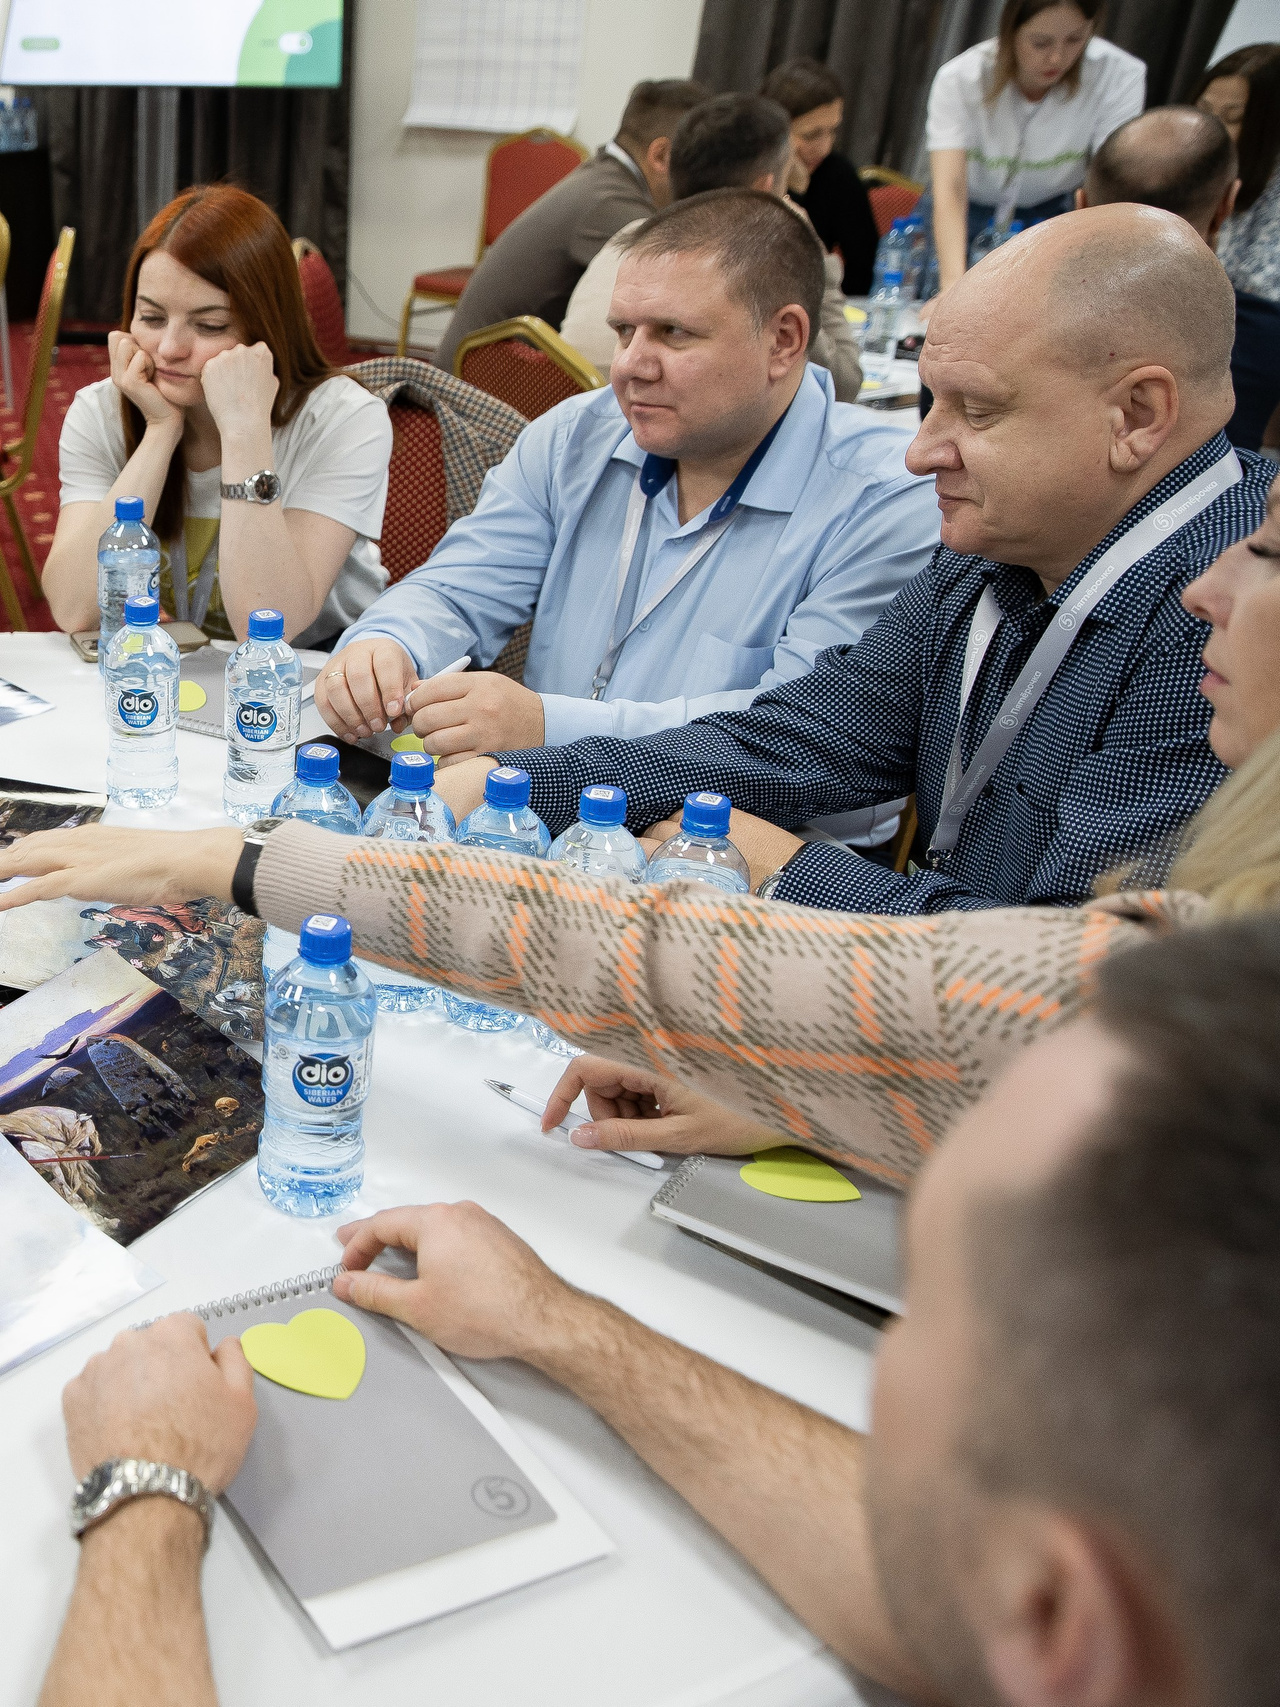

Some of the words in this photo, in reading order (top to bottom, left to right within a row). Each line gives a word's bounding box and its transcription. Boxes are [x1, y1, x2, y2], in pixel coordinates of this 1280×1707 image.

[1171, 481, 1218, 518] Пятёрочка
[1071, 565, 1115, 614] Пятёрочка
[1010, 670, 1042, 716] Пятёрочка
[123, 697, 152, 712] dio
[241, 710, 271, 726] dio
[243, 727, 269, 735] SIBERIAN
[301, 1064, 346, 1084] dio
[304, 1088, 343, 1096] SIBERIAN
